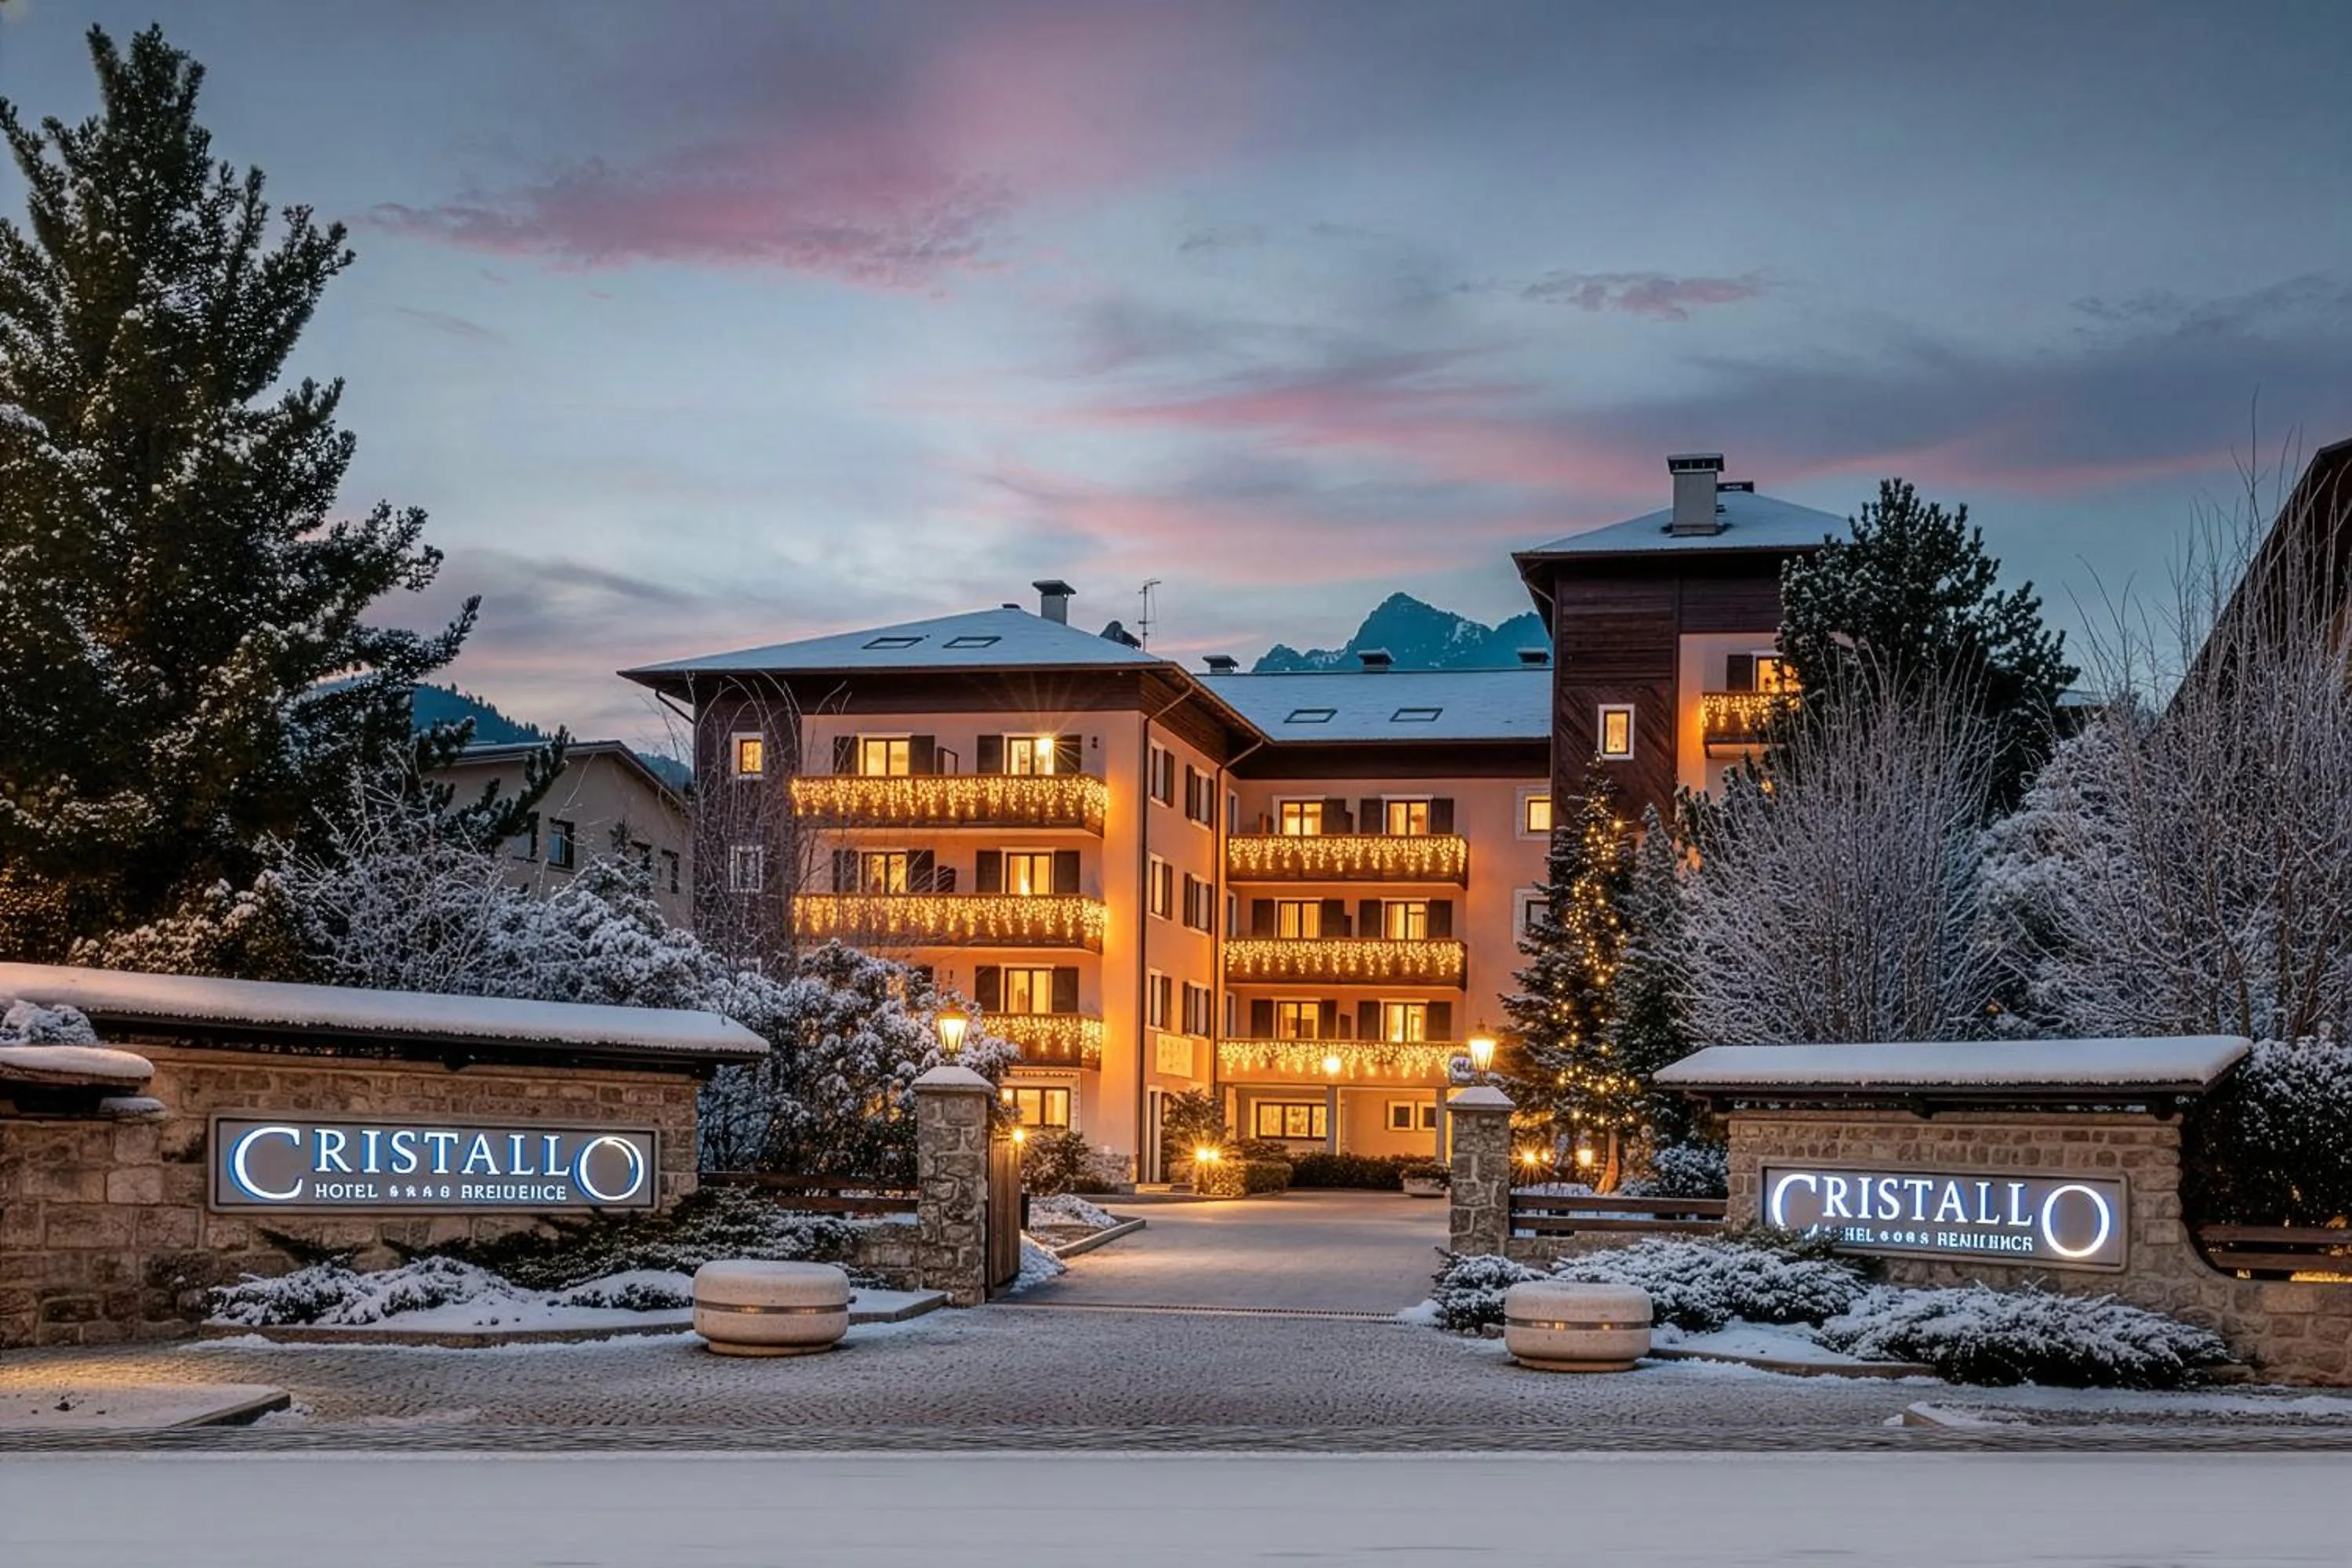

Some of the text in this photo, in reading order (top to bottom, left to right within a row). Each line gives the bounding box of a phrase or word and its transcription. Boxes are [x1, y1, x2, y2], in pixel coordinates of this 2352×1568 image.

[228, 1127, 644, 1200] CRISTALLO
[314, 1183, 379, 1199] HOTEL
[1771, 1174, 2111, 1258] CRISTALLO
